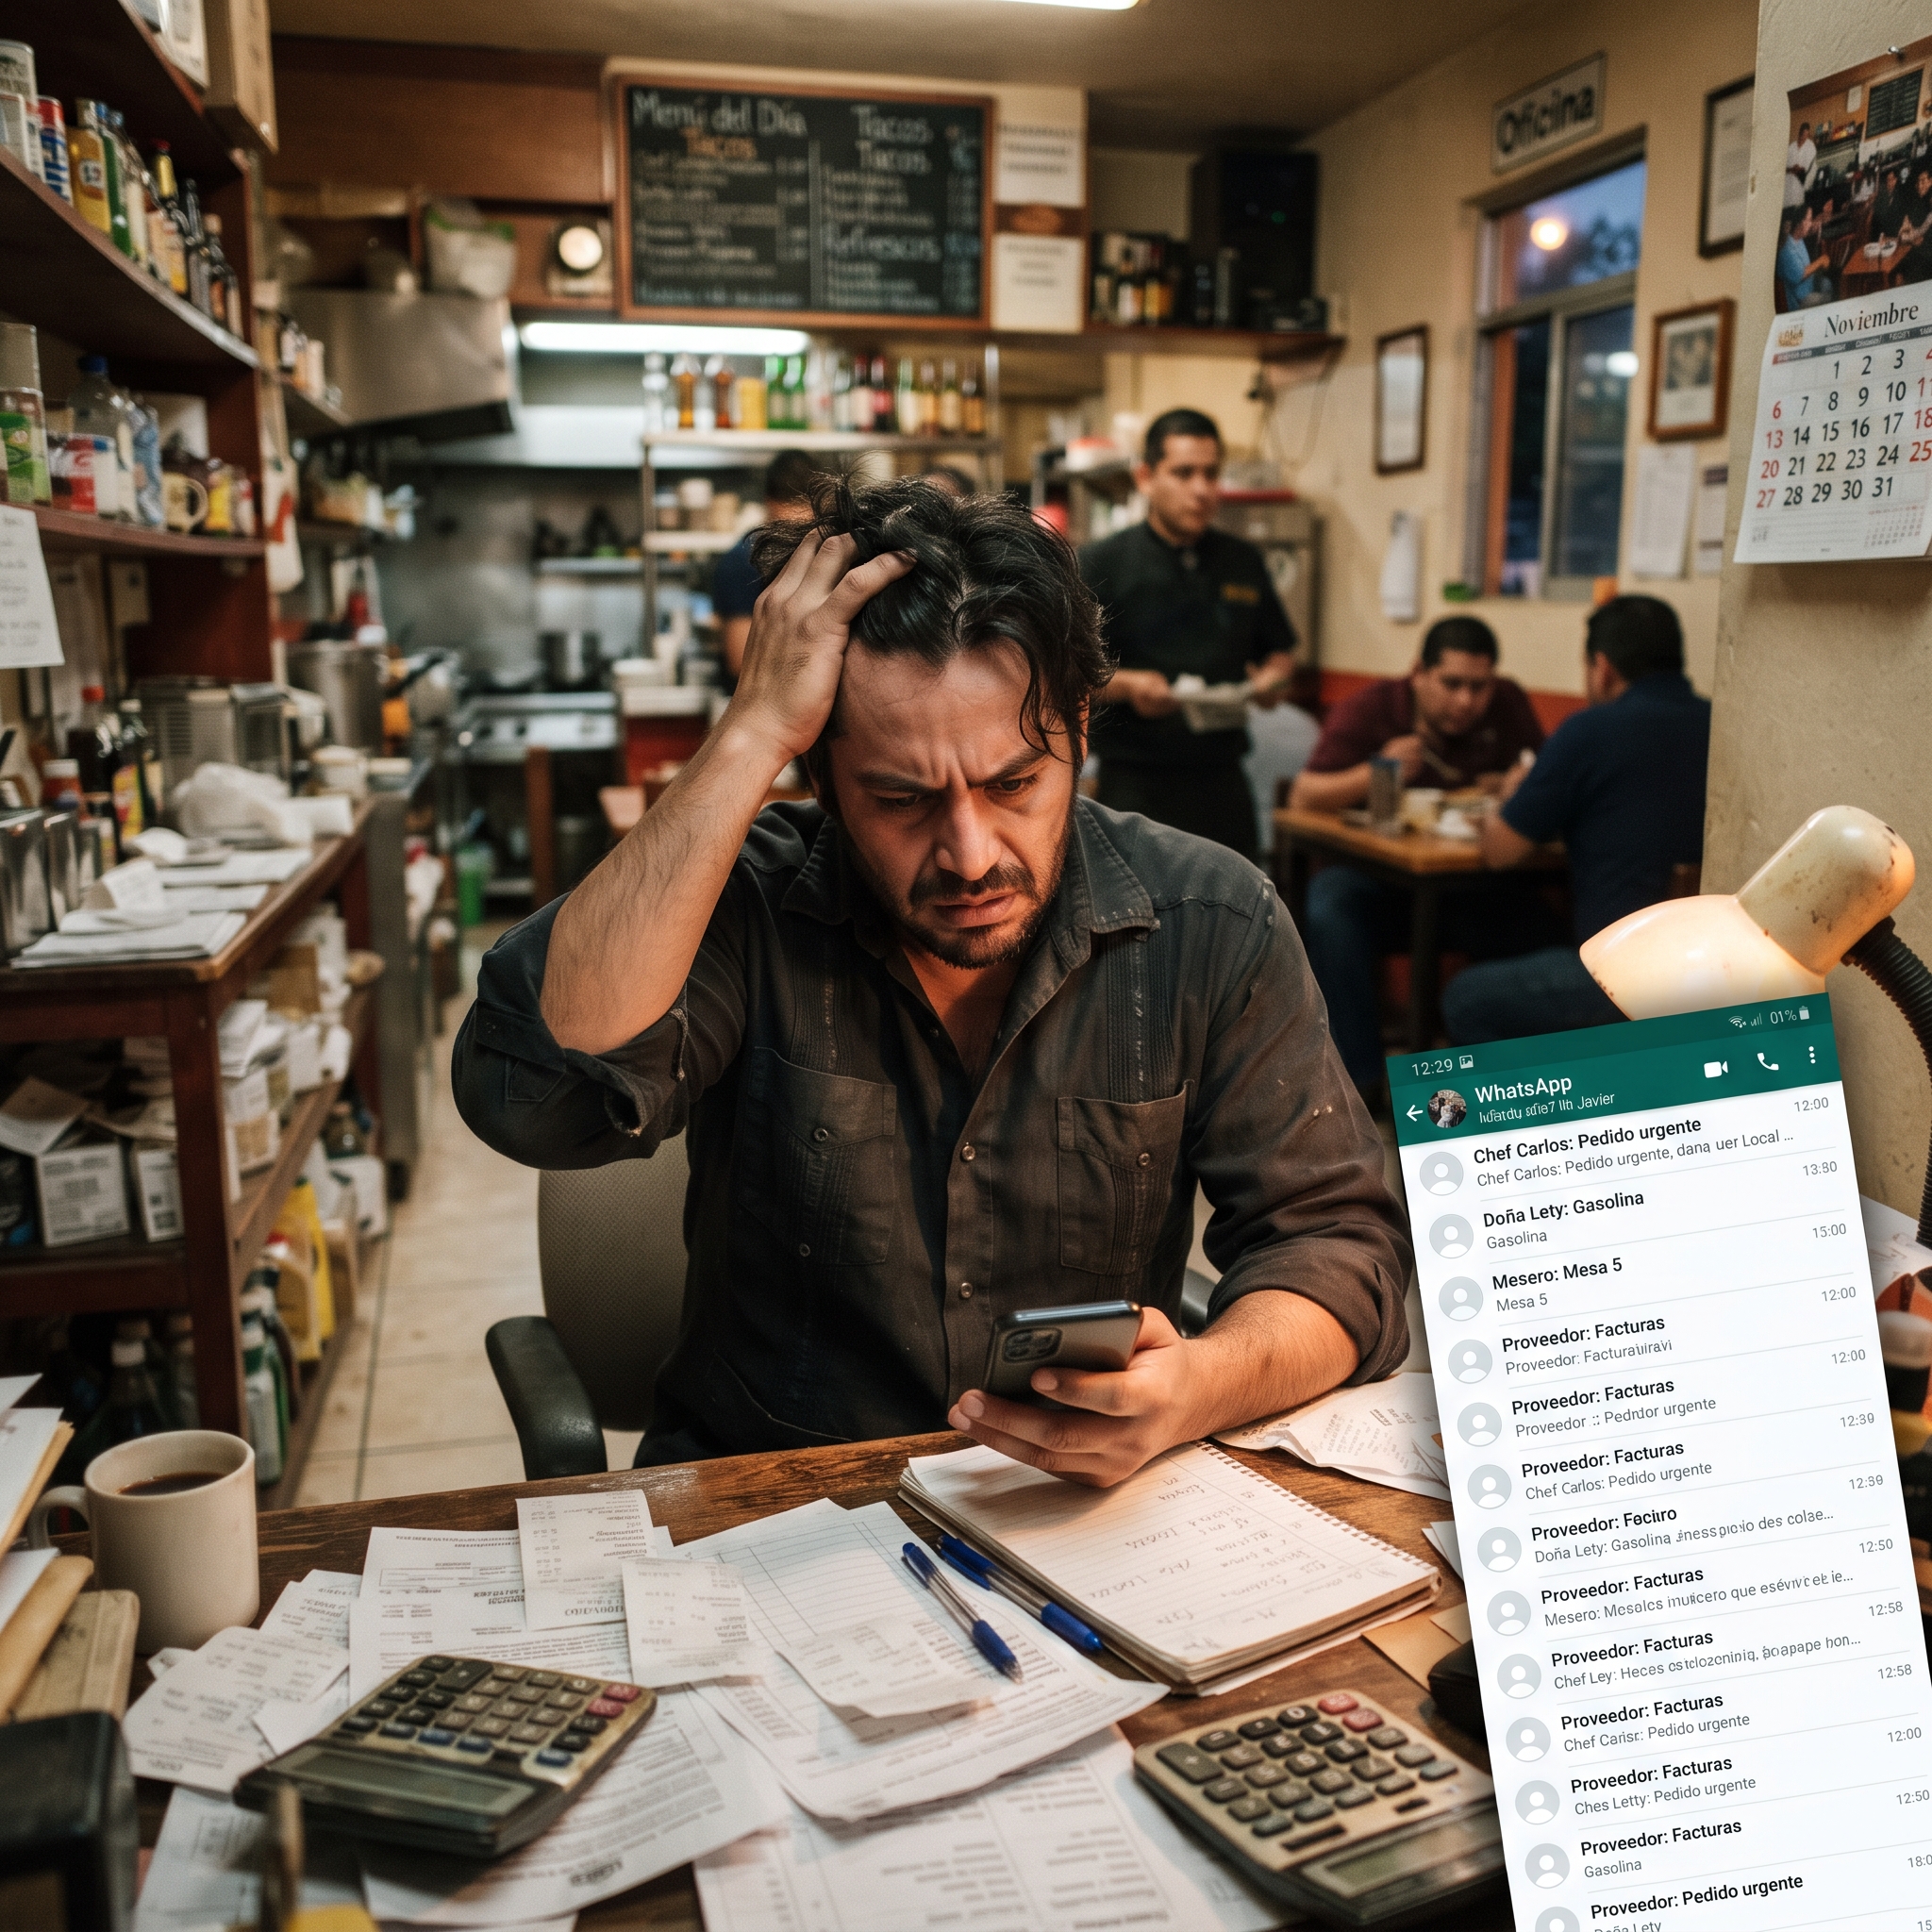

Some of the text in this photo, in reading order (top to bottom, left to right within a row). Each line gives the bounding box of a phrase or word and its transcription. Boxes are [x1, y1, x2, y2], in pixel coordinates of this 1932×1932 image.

[850, 104, 934, 143] Tacos
[1496, 85, 1593, 155] Oficina
[1824, 302, 1919, 338] Noviembre
[1833, 360, 1840, 379] 1
[1860, 356, 1873, 375] 2
[1893, 349, 1906, 370] 3
[1772, 401, 1782, 419] 6
[1801, 396, 1809, 416] 7
[1827, 391, 1840, 411] 8
[1857, 387, 1870, 408] 9
[1886, 380, 1907, 402] 10
[1766, 407, 1932, 449] 13 14 15 16 17 18
[1760, 440, 1932, 479] 20 21 22 23 24 25
[1756, 476, 1893, 508] 27 28 29 30 31
[1411, 1008, 1797, 1076] 12:29 01%
[1474, 1076, 1573, 1105] WhatsApp
[1577, 1092, 1615, 1110] Javier
[1794, 1097, 1829, 1111] 12:00
[1474, 1120, 1702, 1164] Chef Carlos: Pedido urgente
[1477, 1170, 1510, 1187] Chef
[1514, 1164, 1561, 1181] Carlos:
[1565, 1156, 1613, 1174] Pedido
[1617, 1149, 1674, 1167] urgente,
[1716, 1139, 1739, 1151] uer
[1742, 1129, 1780, 1148] Local
[1483, 1191, 1644, 1228] Doña Lety: Gasolina
[1487, 1230, 1548, 1249] Gasolina
[1812, 1224, 1847, 1239] 15:00
[1492, 1257, 1623, 1291] Mesero: Mesa 5
[1497, 1292, 1548, 1312] Mesa 5
[1821, 1286, 1857, 1302] 12:00
[1502, 1318, 1666, 1353] Proveedor: Facturas
[1506, 1353, 1580, 1375] Proveedor:
[1831, 1349, 1866, 1364] 12:00
[1511, 1381, 1675, 1416] Proveedor: Facturas
[1516, 1416, 1587, 1438] Proveedor
[1663, 1399, 1717, 1417] urgente
[1522, 1444, 1685, 1478] Proveedor: Facturas
[1526, 1463, 1712, 1500] Chef Carlos: Pedido urgente
[1532, 1517, 1620, 1541] Proveedor:
[1535, 1545, 1572, 1563] Doña
[1575, 1542, 1607, 1557] Lety:
[1611, 1534, 1672, 1552] Gasolina
[1758, 1516, 1783, 1530] des
[1858, 1539, 1893, 1554] 12:50
[1541, 1570, 1705, 1605] Proveedor: Facturas
[1544, 1608, 1601, 1627] Mesero:
[1730, 1587, 1757, 1602] que
[1868, 1601, 1904, 1617] 12:58
[1551, 1633, 1714, 1668] Proveedor: Facturas
[1555, 1673, 1587, 1690] Chef
[1590, 1671, 1617, 1686] Ley:
[1620, 1664, 1665, 1680] Heces
[1877, 1664, 1912, 1679] 12:58
[1561, 1696, 1724, 1731] Proveedor: Facturas
[1564, 1735, 1596, 1753] Chef
[1647, 1722, 1694, 1740] Pedido
[1698, 1715, 1750, 1734] urgente
[1887, 1727, 1922, 1742] 12:00
[1570, 1758, 1733, 1794] Proveedor: Facturas
[1574, 1778, 1757, 1815] Ches Letty: Pedido urgente
[1896, 1790, 1930, 1805] 12:50
[1580, 1822, 1742, 1857] Proveedor: Facturas
[1584, 1859, 1642, 1878] Gasolina
[1591, 1876, 1804, 1920] Proveedor: Pedido urgente
